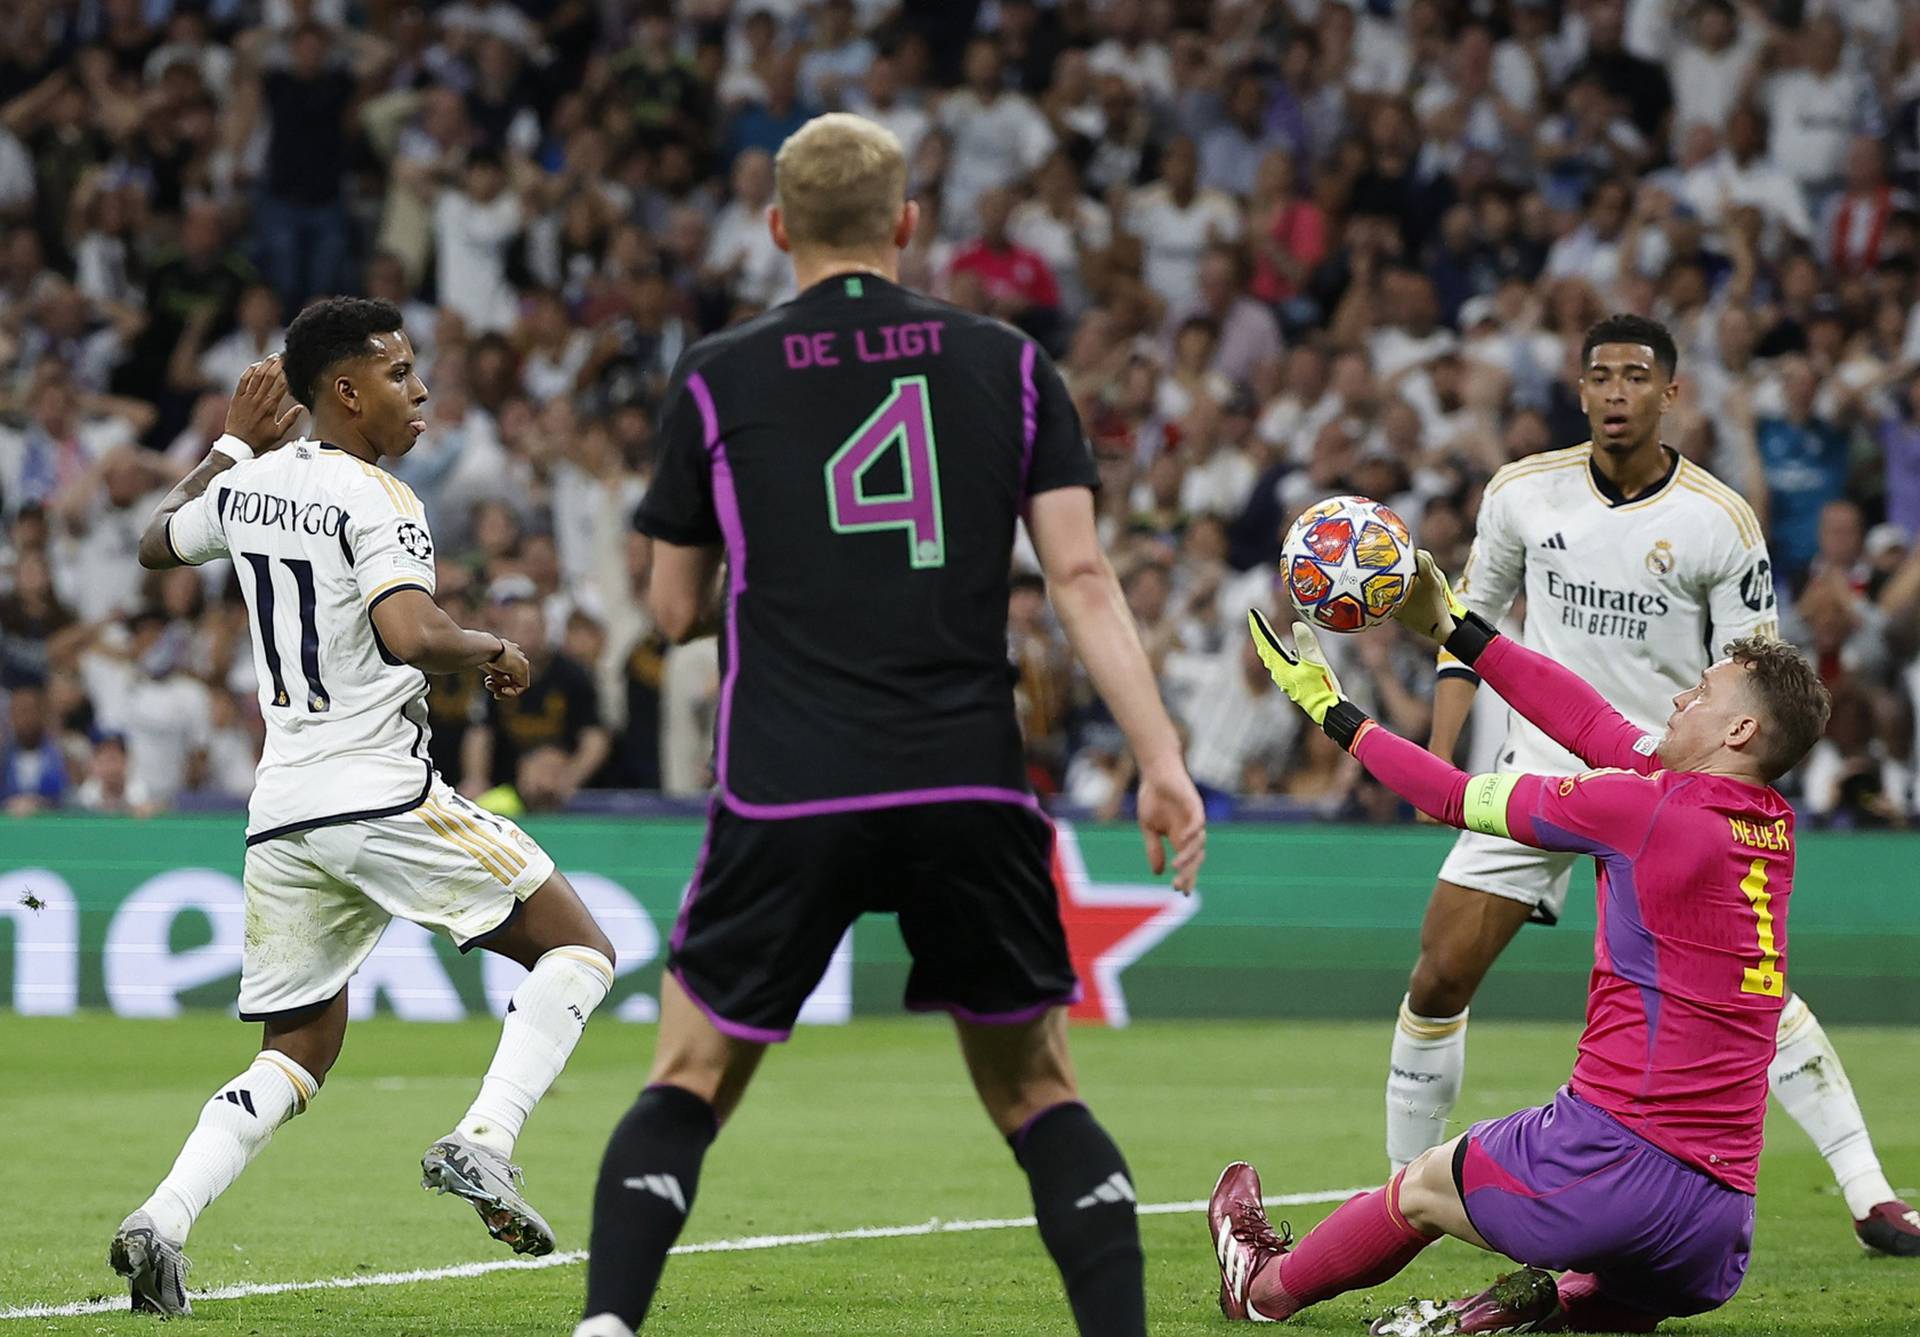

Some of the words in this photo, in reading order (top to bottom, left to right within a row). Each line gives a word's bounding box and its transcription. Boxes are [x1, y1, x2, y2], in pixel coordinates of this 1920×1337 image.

[783, 332, 840, 369] DE
[854, 320, 945, 363] LIGT
[824, 374, 945, 570] 4
[229, 491, 341, 537] RODRYGO
[1547, 570, 1669, 616] Emirates
[240, 551, 330, 713] 11
[1587, 613, 1648, 640] BETTER
[1728, 817, 1790, 850] NEUER
[1739, 858, 1785, 998] 1
